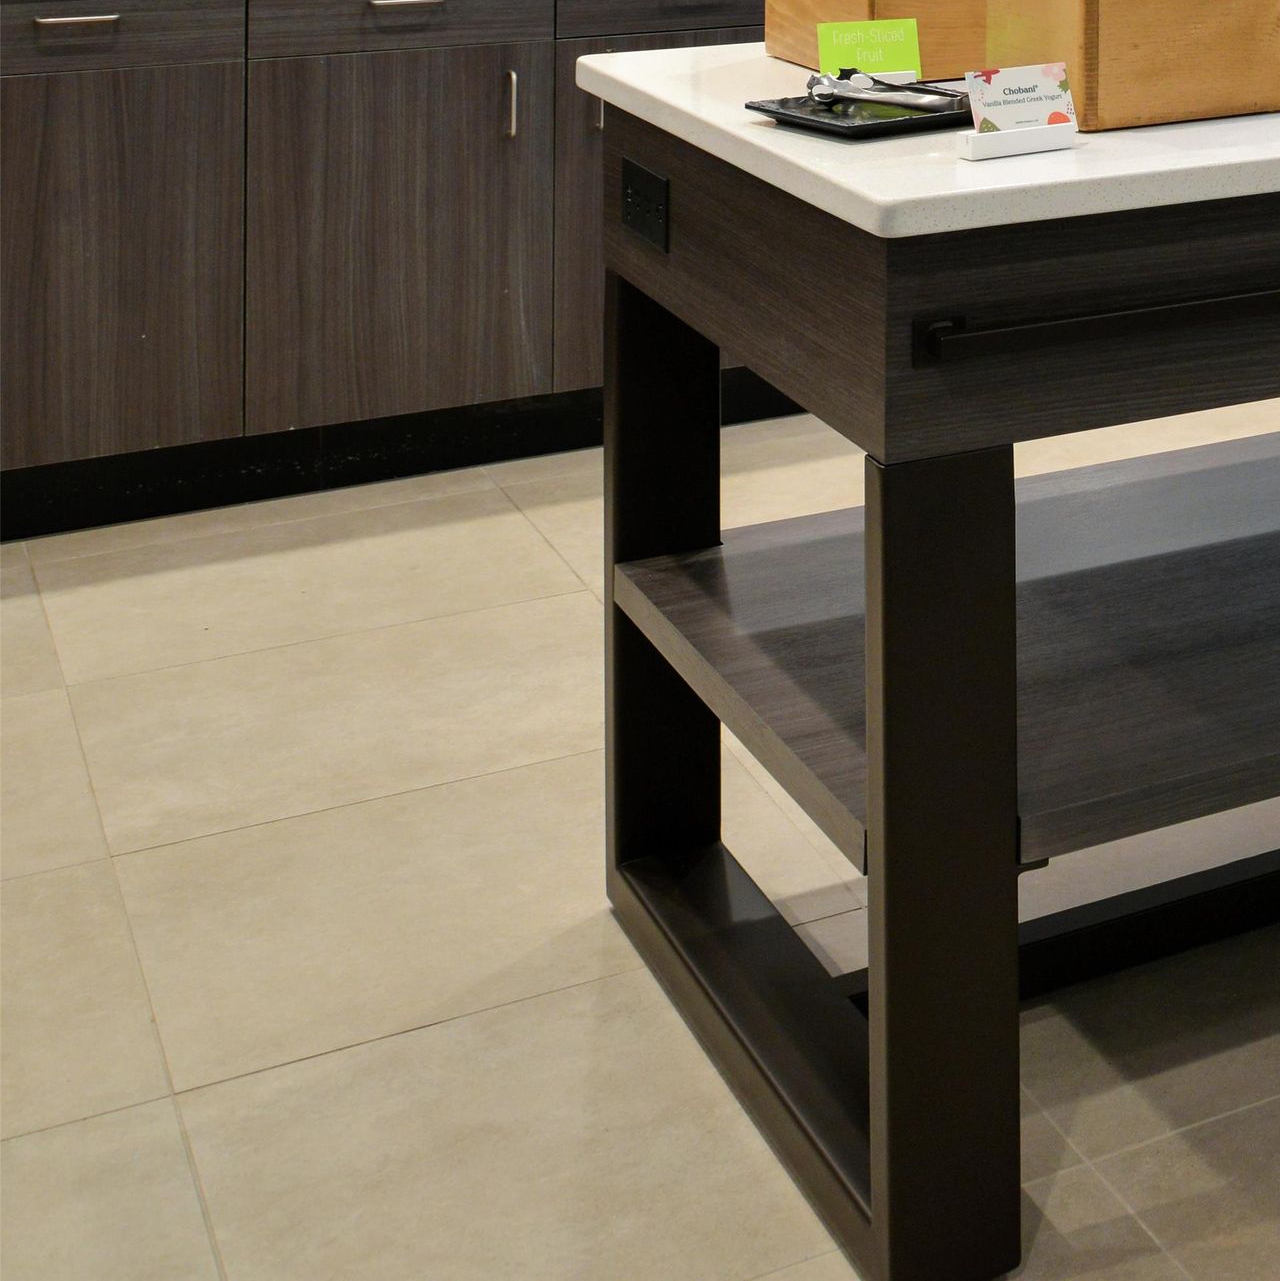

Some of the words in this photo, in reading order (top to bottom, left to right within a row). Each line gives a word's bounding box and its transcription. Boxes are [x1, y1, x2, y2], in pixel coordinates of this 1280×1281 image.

[856, 46, 884, 63] Fruit
[982, 100, 1002, 108] Vanilla
[1002, 97, 1026, 106] Blended
[1026, 95, 1043, 103] Greek
[1044, 93, 1063, 102] Yogurt
